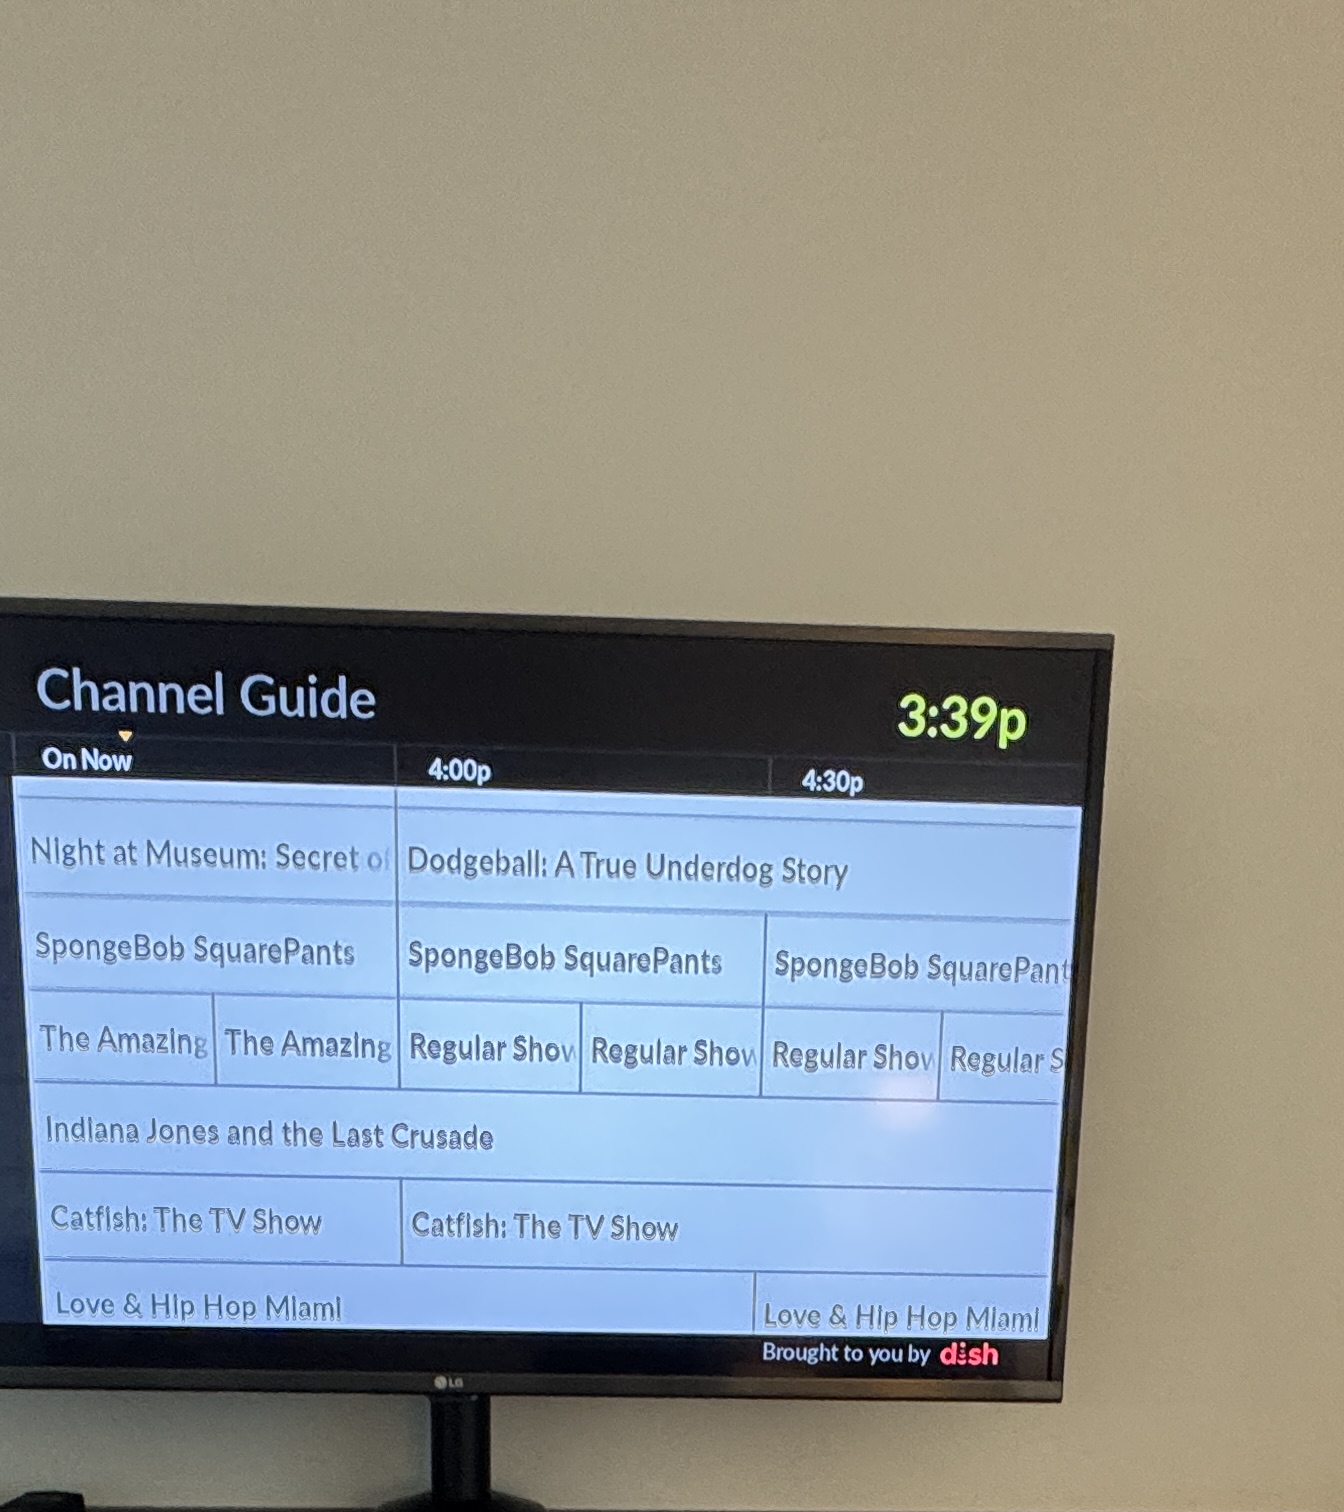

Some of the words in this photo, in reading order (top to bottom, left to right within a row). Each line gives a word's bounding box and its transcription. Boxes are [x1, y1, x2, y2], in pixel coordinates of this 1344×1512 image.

[36, 666, 224, 716] Channel
[240, 673, 376, 719] Guide
[897, 690, 1027, 748] 3:39p
[42, 746, 76, 770] On
[82, 746, 132, 771] Now
[428, 756, 491, 785] 4:00p
[802, 768, 864, 796] 4:30p
[31, 835, 106, 867] Night
[113, 842, 138, 865] at
[146, 838, 268, 870] Museum:
[275, 841, 359, 870] Secret
[408, 845, 547, 879] Dodgeball:
[555, 850, 575, 878] A
[580, 850, 636, 878] True
[646, 852, 773, 886] Underdog
[782, 857, 848, 890] Story
[36, 931, 185, 966] SpongeBob
[193, 935, 355, 970] SquarePants
[408, 939, 556, 974] SpongeBob
[564, 944, 723, 980] SquarePants
[775, 949, 919, 983] SpongeBob
[40, 1023, 90, 1052] The
[96, 1024, 208, 1059] Amazing
[224, 1026, 275, 1056] The
[281, 1028, 392, 1063] Amazing
[410, 1031, 506, 1066] Regular
[592, 1035, 687, 1070] Regular
[772, 1039, 867, 1074] Regular
[950, 1043, 1045, 1078] Regular
[46, 1114, 139, 1144] Indiana
[146, 1116, 219, 1146] Jones
[227, 1119, 274, 1146] and
[282, 1119, 323, 1147] the
[332, 1120, 384, 1148] Last
[391, 1121, 494, 1151] Crusade
[51, 1203, 148, 1233] Catfish:
[153, 1205, 203, 1233] The
[209, 1206, 246, 1234] TV
[253, 1207, 323, 1235] Show
[412, 1210, 506, 1238] Catfish:
[513, 1211, 561, 1240] The
[568, 1213, 605, 1240] TV
[610, 1213, 679, 1241] Show
[56, 1289, 115, 1316] Love
[124, 1290, 141, 1317] &
[151, 1291, 196, 1323] Hip
[204, 1292, 257, 1324] Hop
[265, 1293, 342, 1321] Miami
[765, 1301, 822, 1328] Love
[829, 1302, 846, 1329] &
[855, 1302, 898, 1335] Hip
[905, 1303, 957, 1336] Hop
[966, 1304, 1040, 1333] Miami
[764, 1340, 839, 1366] Brought
[844, 1343, 863, 1364] to
[868, 1346, 905, 1368] you
[907, 1342, 930, 1367] by
[940, 1340, 998, 1366] dish
[448, 1375, 464, 1387] LG
